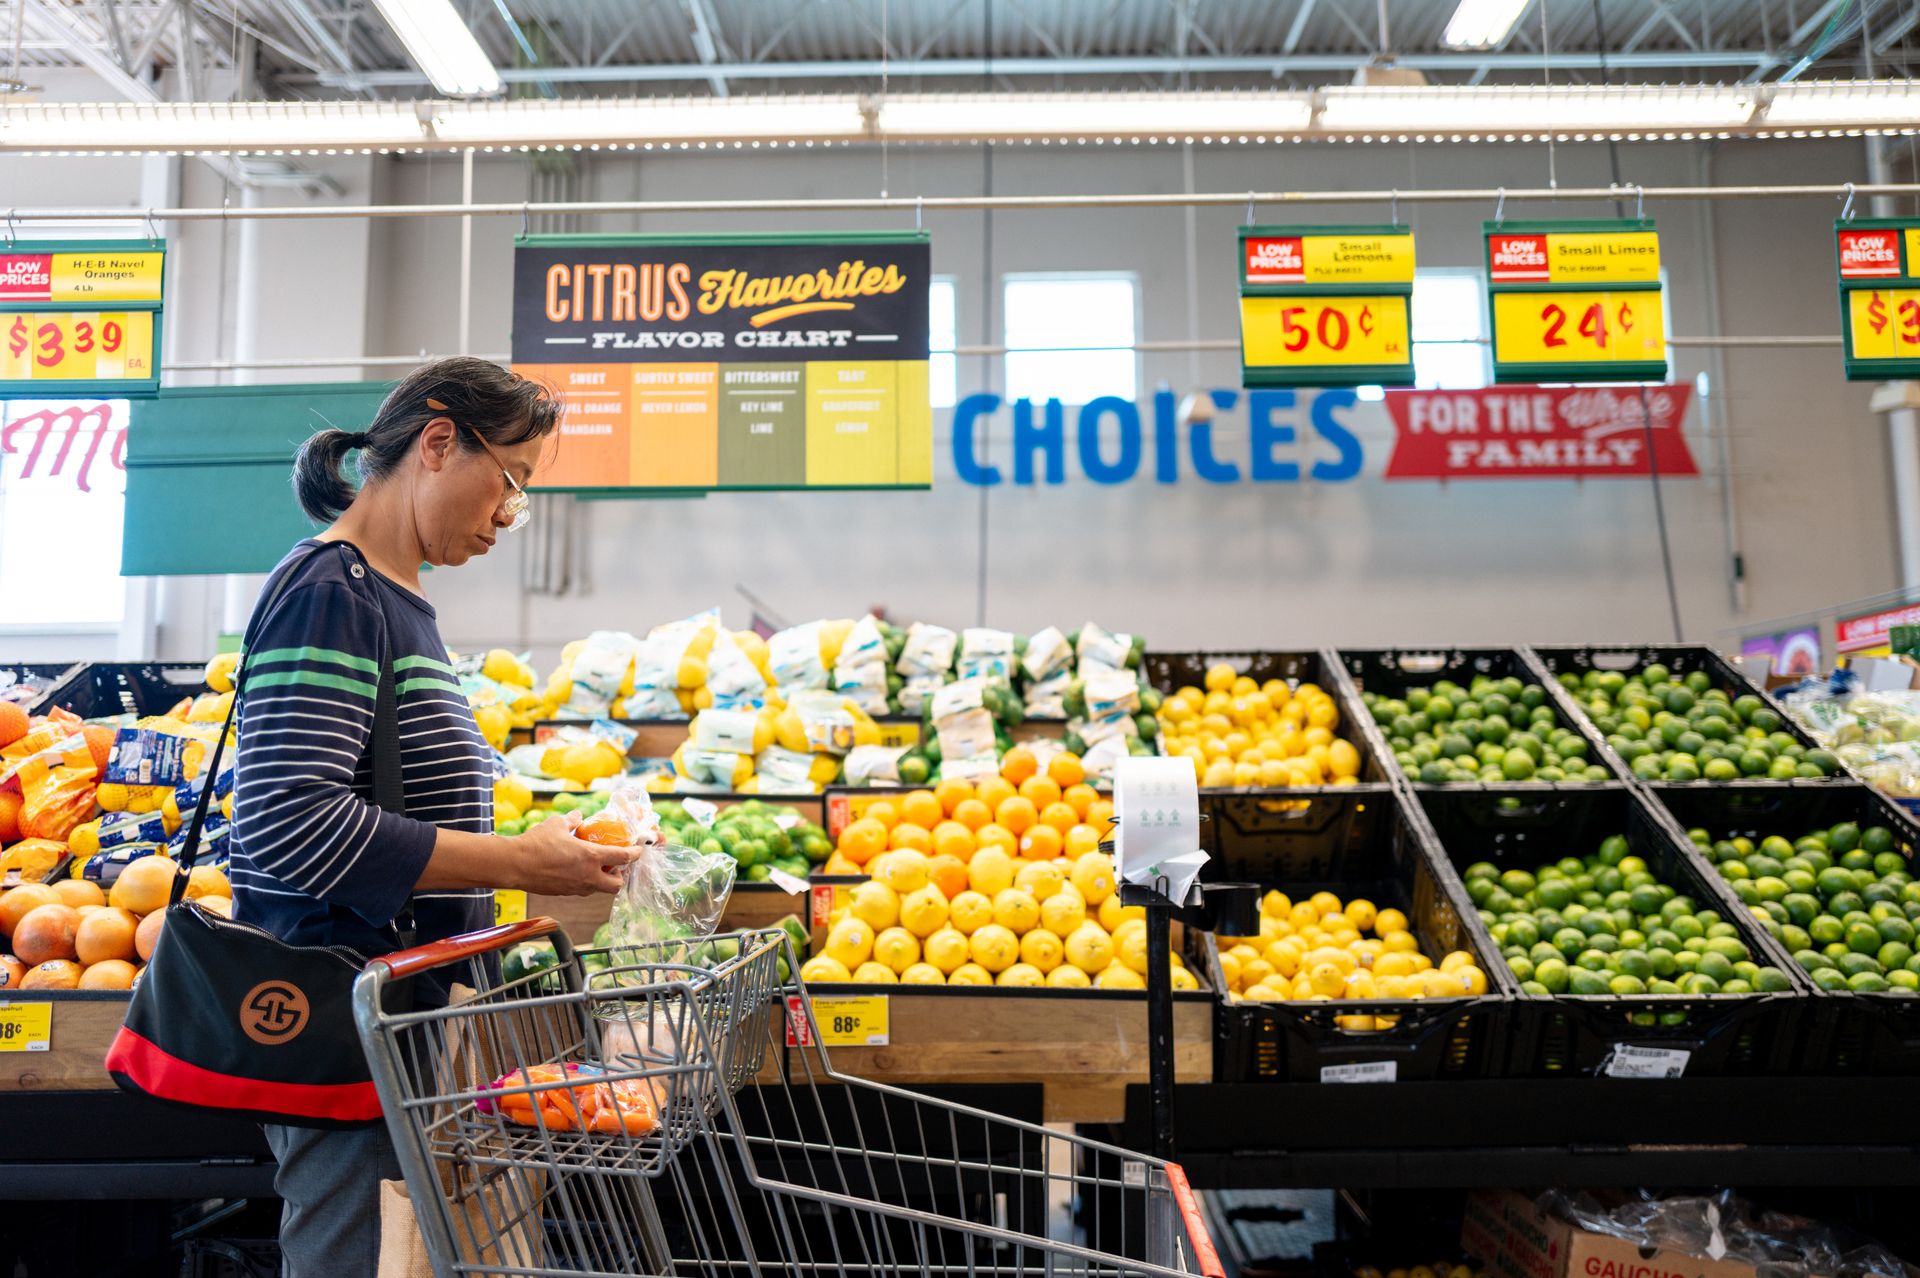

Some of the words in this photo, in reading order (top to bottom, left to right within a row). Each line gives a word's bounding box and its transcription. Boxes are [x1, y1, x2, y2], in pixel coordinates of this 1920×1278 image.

[1339, 242, 1382, 252] Small
[1501, 241, 1537, 254] LOW
[1850, 237, 1885, 249] LOW
[1257, 243, 1293, 256] LOW
[1559, 245, 1602, 256] Small
[1608, 245, 1655, 255] Limes
[1843, 248, 1895, 262] PRICES
[1249, 255, 1302, 268] PRICES
[1334, 252, 1392, 262] Lemons
[1494, 252, 1546, 265] PRICES
[7, 262, 41, 273] LOW
[73, 260, 105, 268] H-E-B
[110, 260, 144, 268] Navel
[0, 274, 49, 286] PRICES
[84, 270, 135, 280] Oranges
[545, 263, 691, 322] CITRUS
[696, 260, 907, 316] Flavorites
[592, 331, 725, 348] FLAVOR
[735, 330, 852, 348] CHART
[569, 372, 606, 384] SWEET
[634, 372, 676, 384] SUBTLY
[678, 372, 714, 384] SWEET
[724, 371, 800, 384] BITTERSWEET
[584, 402, 622, 414] ORANGE
[740, 402, 759, 412] KEY
[760, 402, 784, 412] LIME
[1408, 394, 1479, 433] FOR
[1483, 393, 1554, 432] THE
[1558, 389, 1675, 428] Whole
[750, 423, 773, 434] LIME
[952, 388, 1364, 485] CHOICES
[1447, 439, 1641, 468] FAMILY
[1584, 1256, 1684, 1278] GAUC
